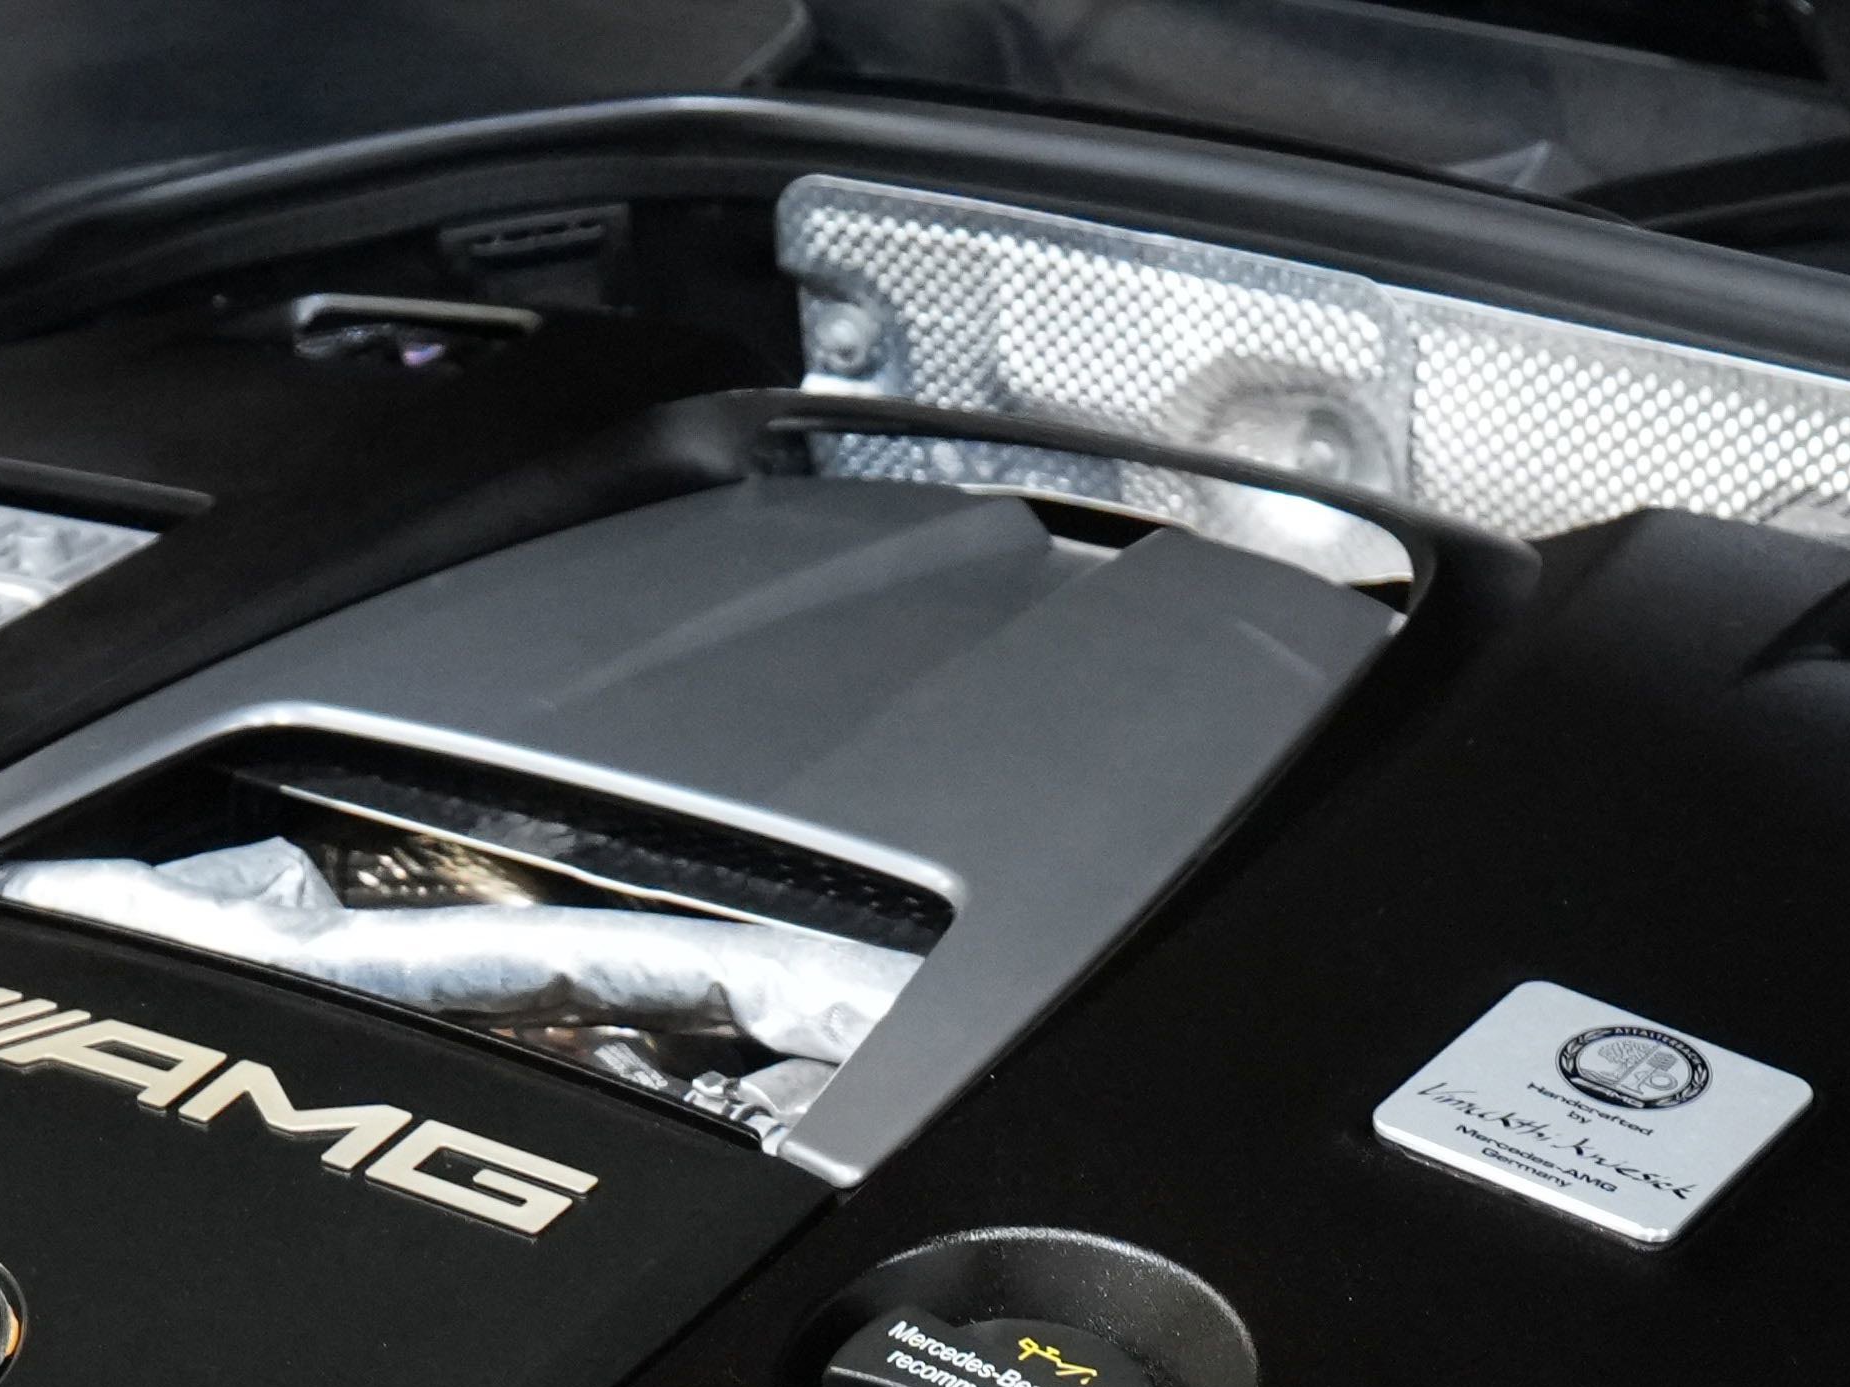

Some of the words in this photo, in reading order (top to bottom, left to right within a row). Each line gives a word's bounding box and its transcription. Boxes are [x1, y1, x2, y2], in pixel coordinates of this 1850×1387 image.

[1527, 1082, 1653, 1136] Handcrafted
[1567, 1111, 1591, 1124] by
[1455, 1125, 1617, 1192] Mercedes-AMG
[1481, 1147, 1573, 1187] Germany
